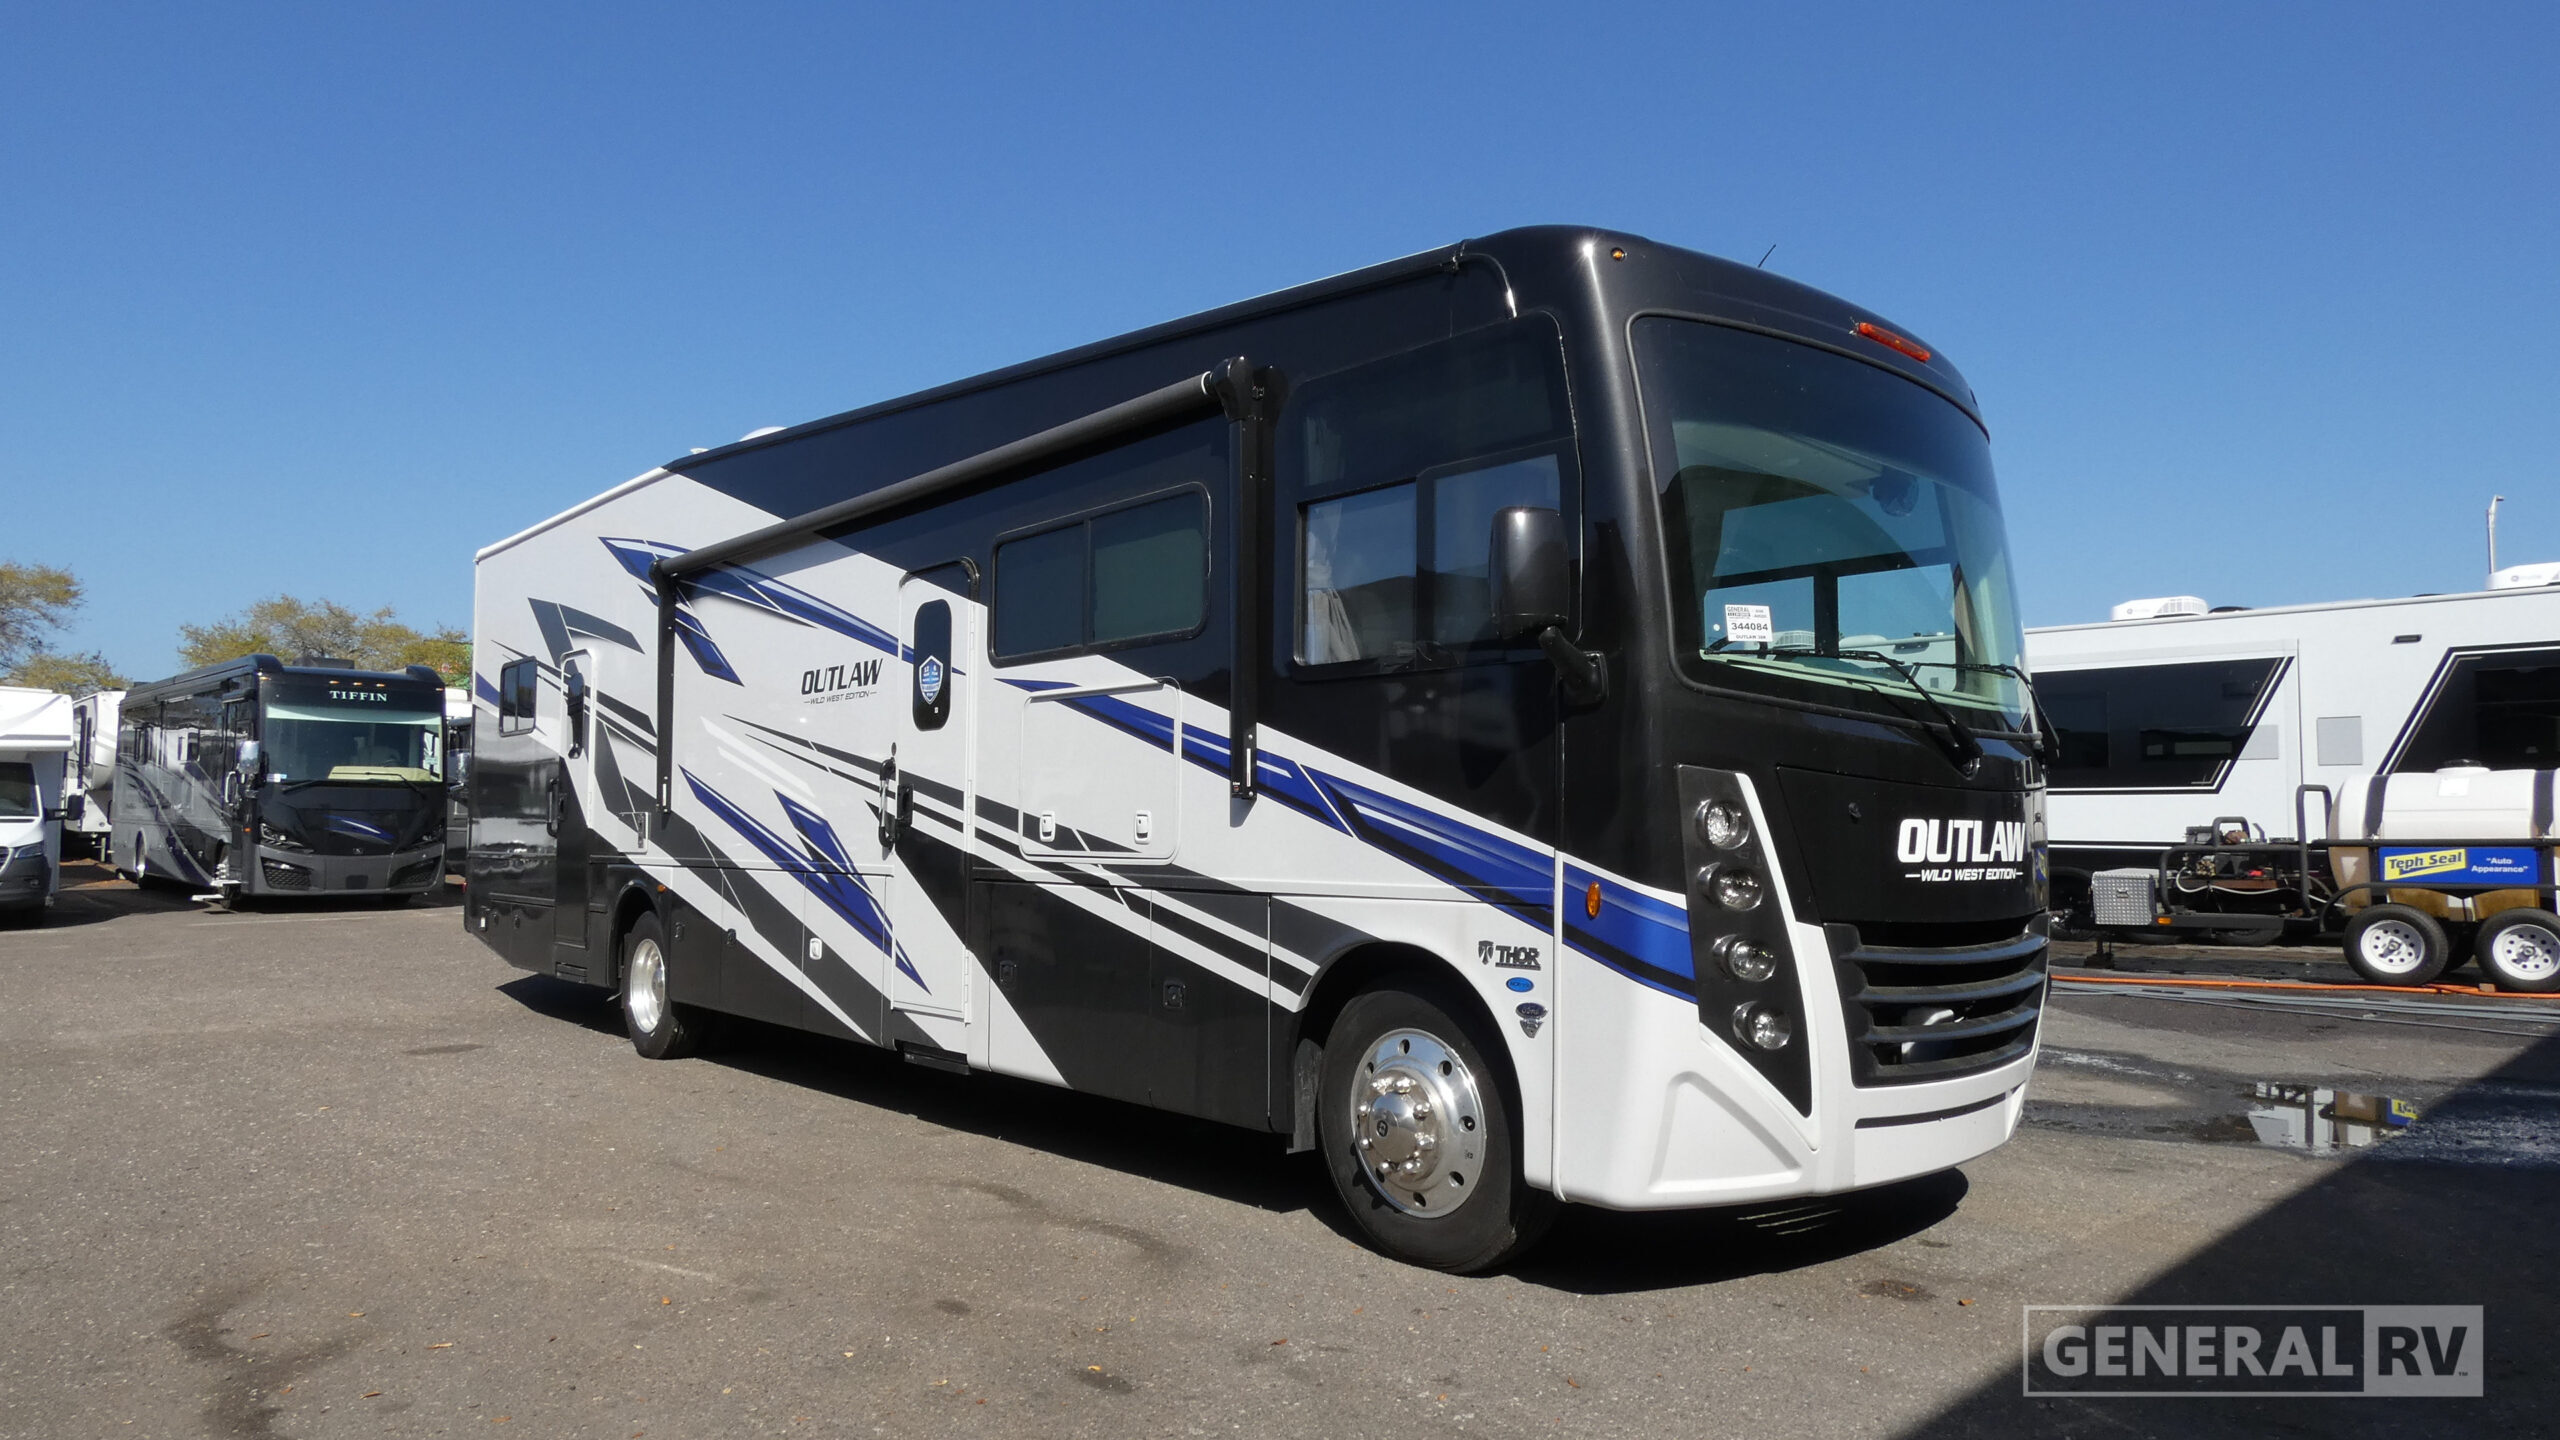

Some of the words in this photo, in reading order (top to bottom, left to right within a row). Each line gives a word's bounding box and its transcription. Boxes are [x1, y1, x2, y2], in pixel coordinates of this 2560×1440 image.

[1731, 622, 1768, 631] 344084
[801, 658, 884, 696] OUTLAW
[329, 690, 388, 702] TIFFIN
[810, 696, 825, 705] WILD
[826, 693, 845, 703] WEST
[845, 690, 870, 701] EDITION
[1897, 818, 2026, 863] OUTLAW
[2389, 857, 2424, 871] Teph
[2429, 851, 2462, 865] Seal
[1921, 869, 1951, 882] WILD
[1954, 868, 1985, 881] WEST
[1985, 867, 2016, 880] EDITION
[1495, 945, 1541, 967] THOR
